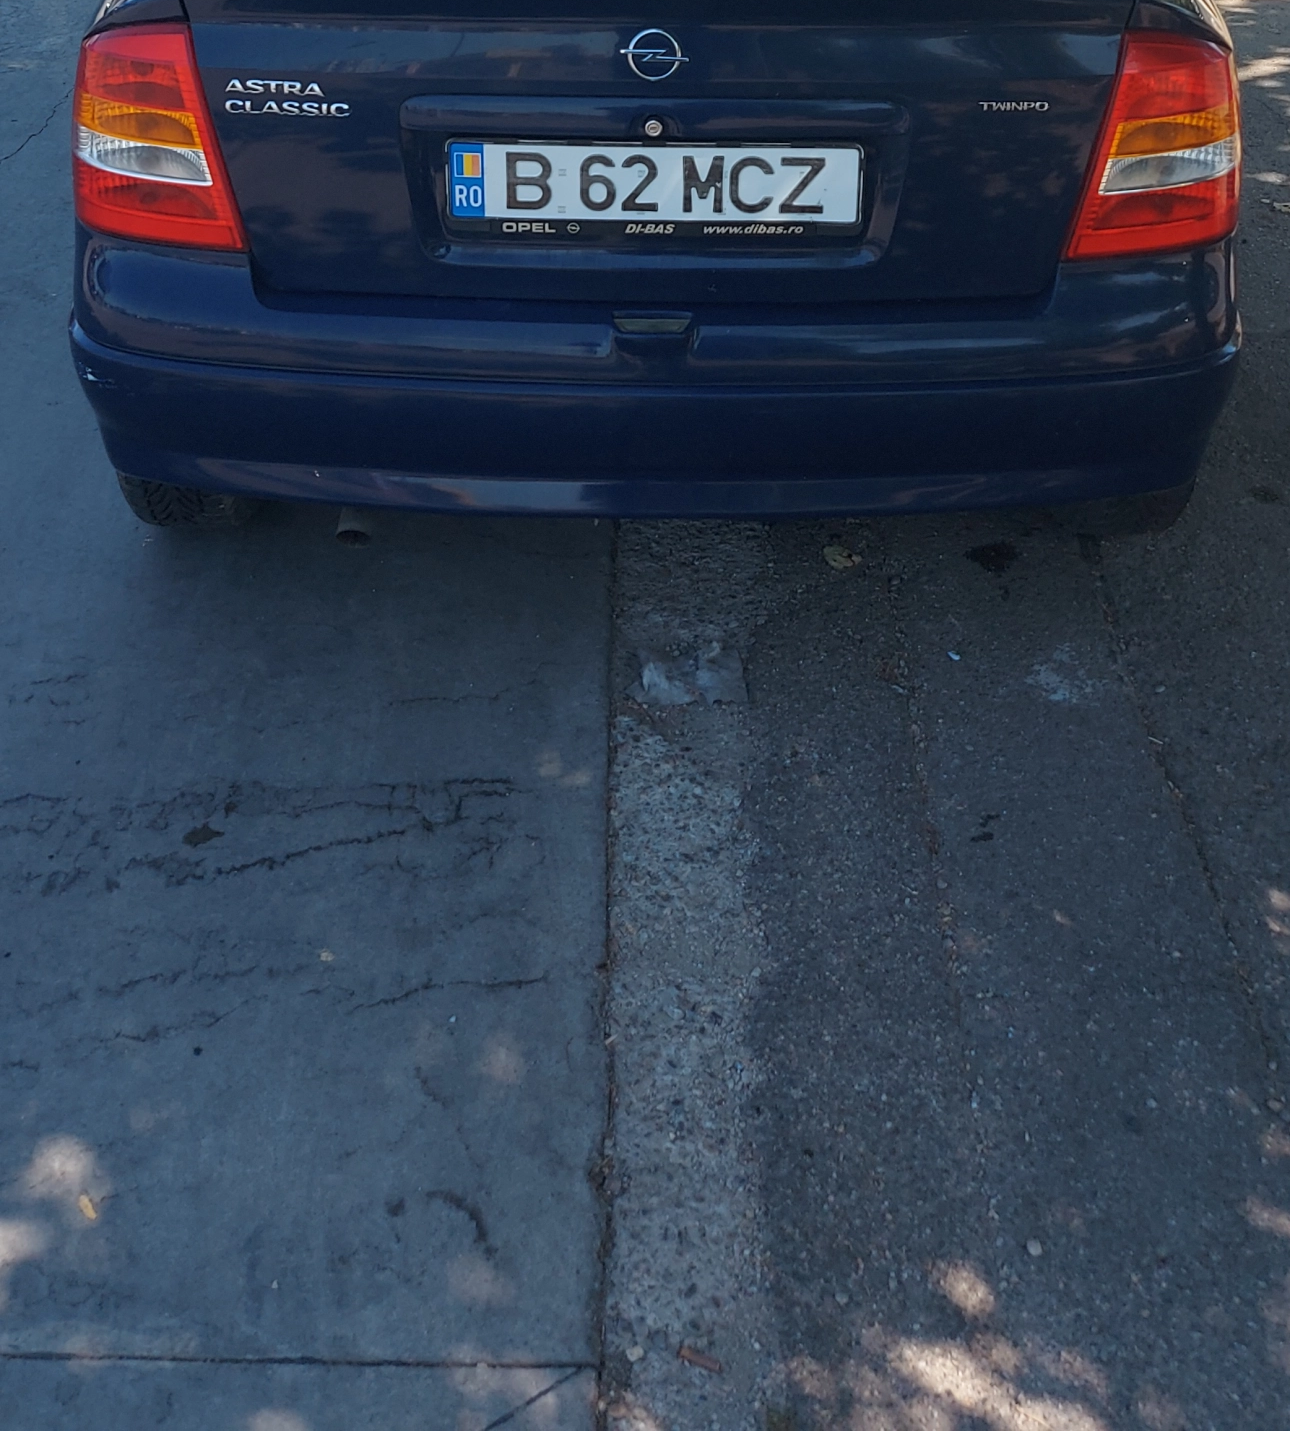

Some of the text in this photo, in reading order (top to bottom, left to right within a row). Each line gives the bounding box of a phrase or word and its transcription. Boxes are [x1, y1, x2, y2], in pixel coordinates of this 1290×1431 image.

[225, 78, 326, 97] ASTRA
[225, 99, 350, 117] CLASSIC
[978, 101, 1049, 111] TWINPO
[505, 151, 827, 214] B 62 MCZ
[454, 184, 482, 208] RO
[502, 222, 556, 234] OPEL
[624, 223, 675, 234] DI-BAS
[703, 224, 804, 235] www.dibas.ro
